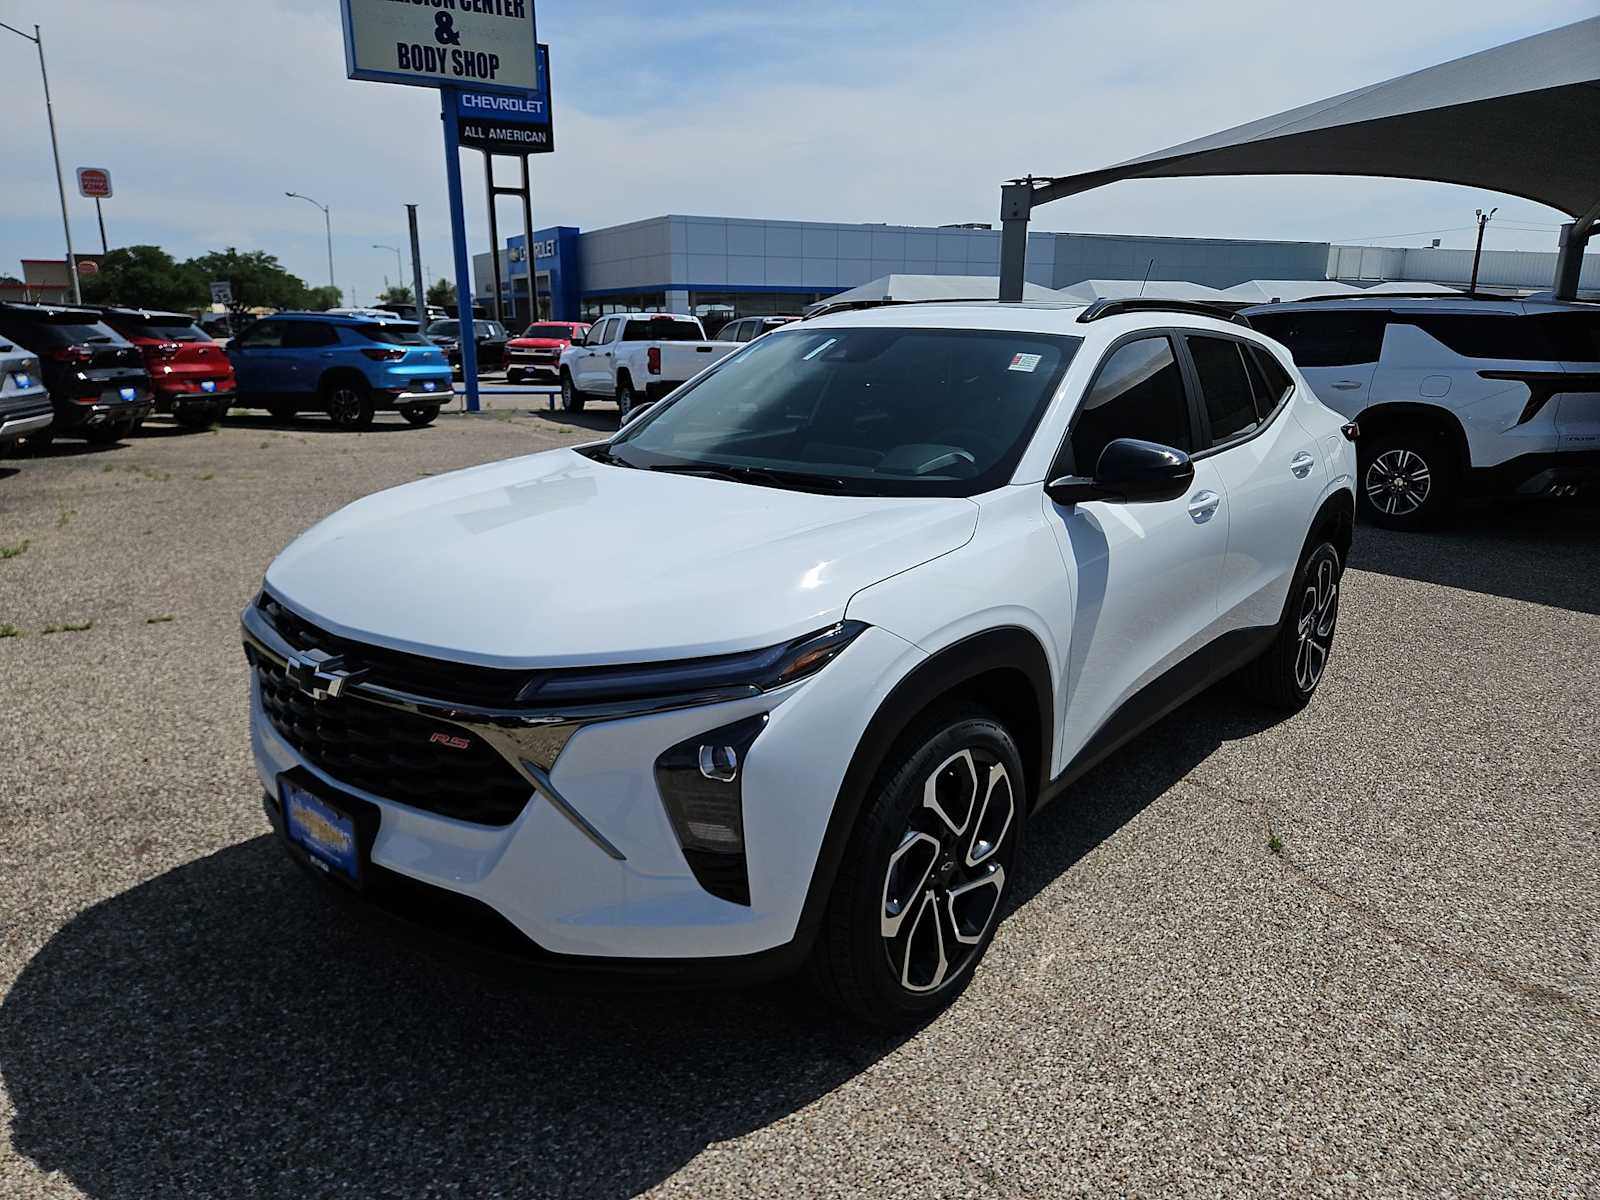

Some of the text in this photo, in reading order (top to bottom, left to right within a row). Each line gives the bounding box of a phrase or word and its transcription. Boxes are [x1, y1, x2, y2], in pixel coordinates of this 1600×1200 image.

[434, 10, 461, 46] &
[396, 42, 500, 80] BODY SHOP
[462, 94, 543, 113] CHEVROLET
[464, 126, 546, 143] ALL AMERICAN
[431, 732, 469, 749] RS
